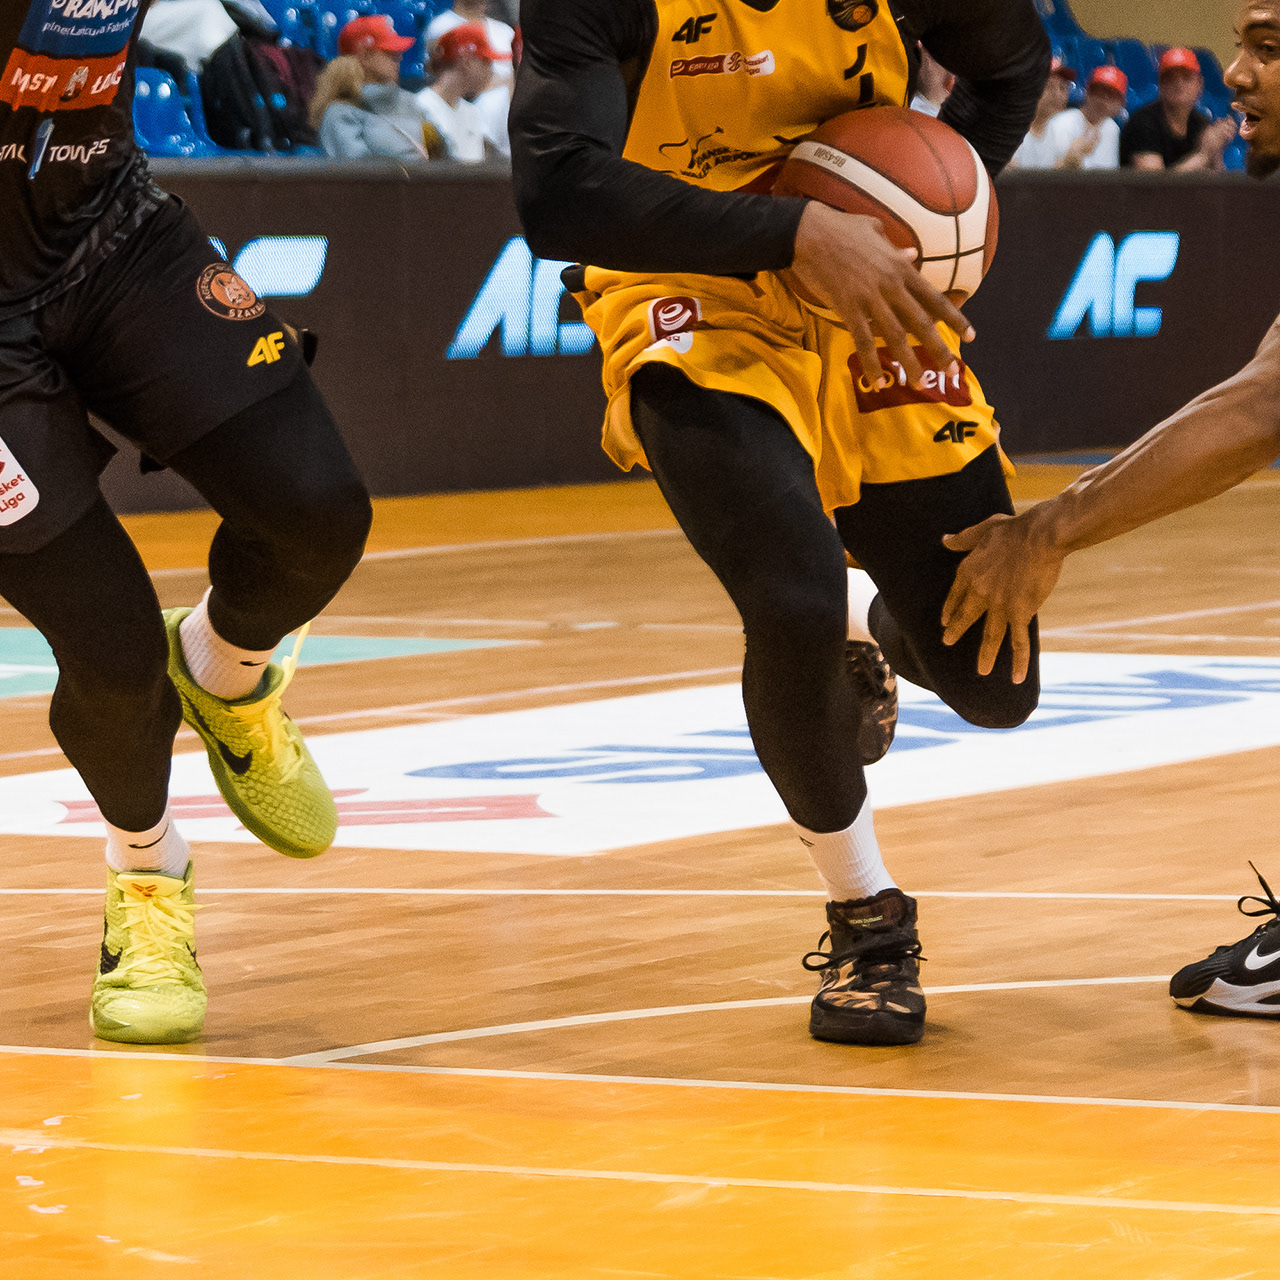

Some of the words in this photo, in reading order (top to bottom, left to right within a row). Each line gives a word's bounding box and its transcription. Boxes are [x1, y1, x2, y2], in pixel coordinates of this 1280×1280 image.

[671, 12, 718, 45] 4F
[246, 331, 285, 368] 4F
[932, 420, 979, 443] 4F
